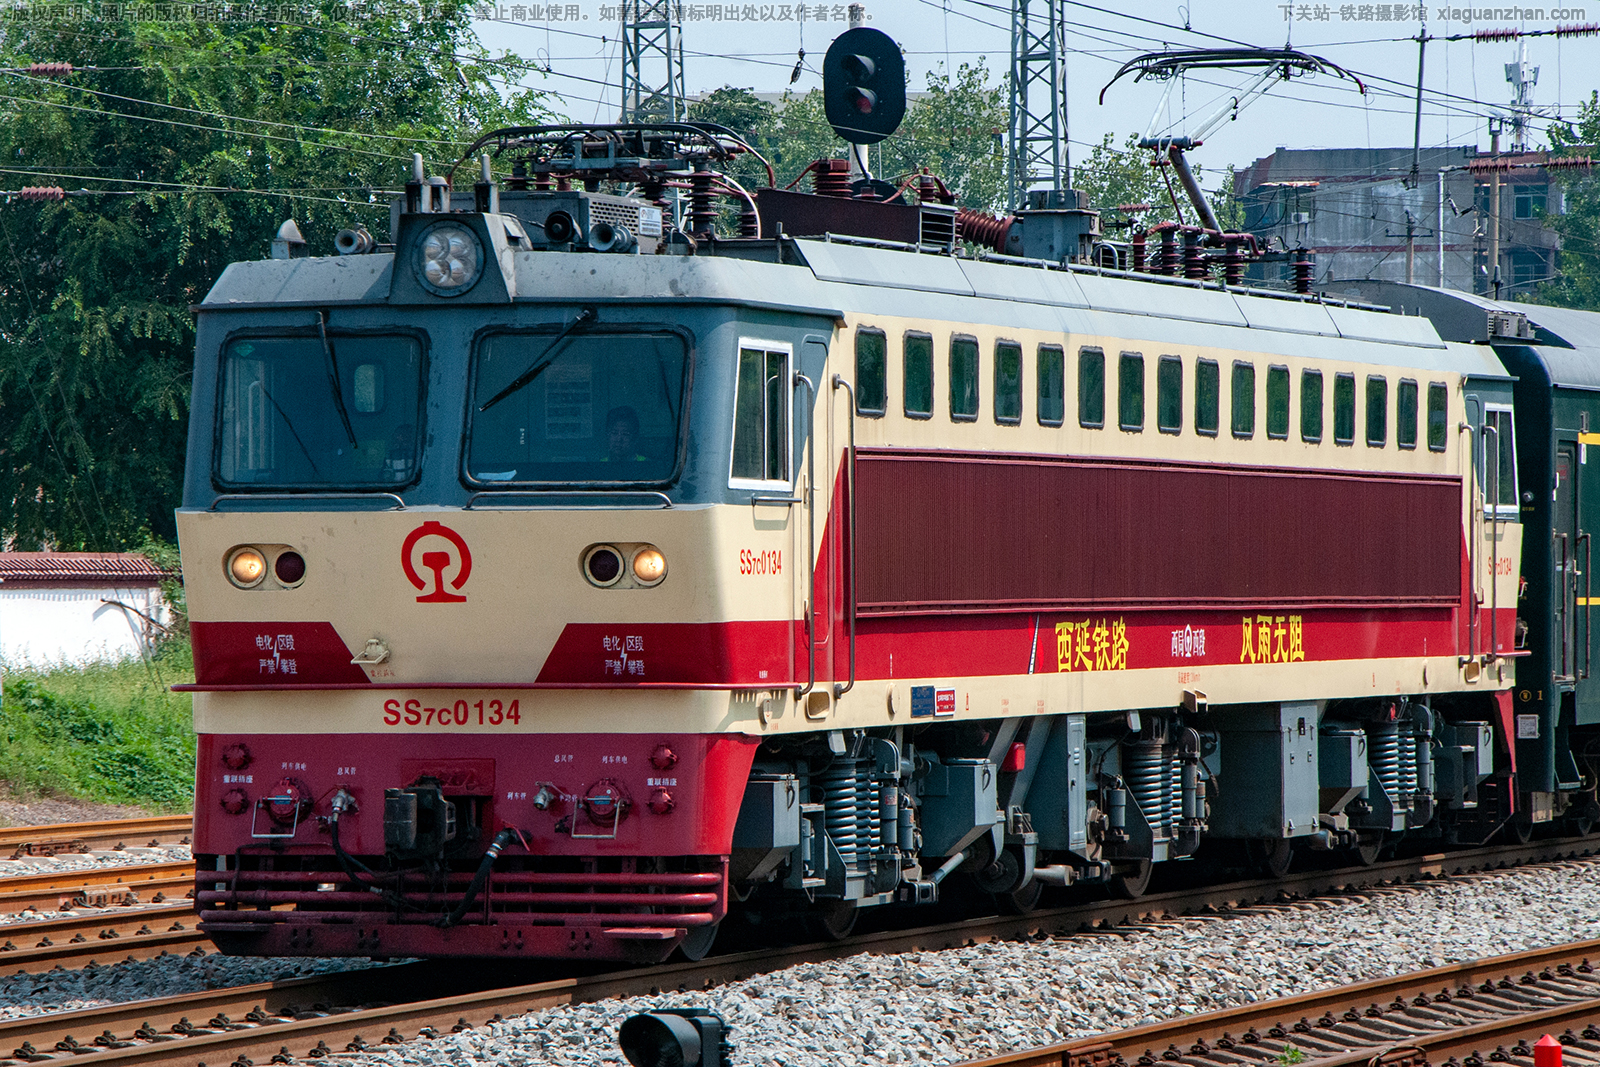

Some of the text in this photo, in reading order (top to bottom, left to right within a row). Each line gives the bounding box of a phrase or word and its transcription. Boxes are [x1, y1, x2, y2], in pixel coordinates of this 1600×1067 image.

[739, 548, 782, 576] SS7C0134
[1055, 616, 1130, 673] 西延铁路
[1240, 614, 1305, 664] 风雨无阻
[1537, 690, 1543, 701] 1
[383, 698, 521, 726] SS7C0134
